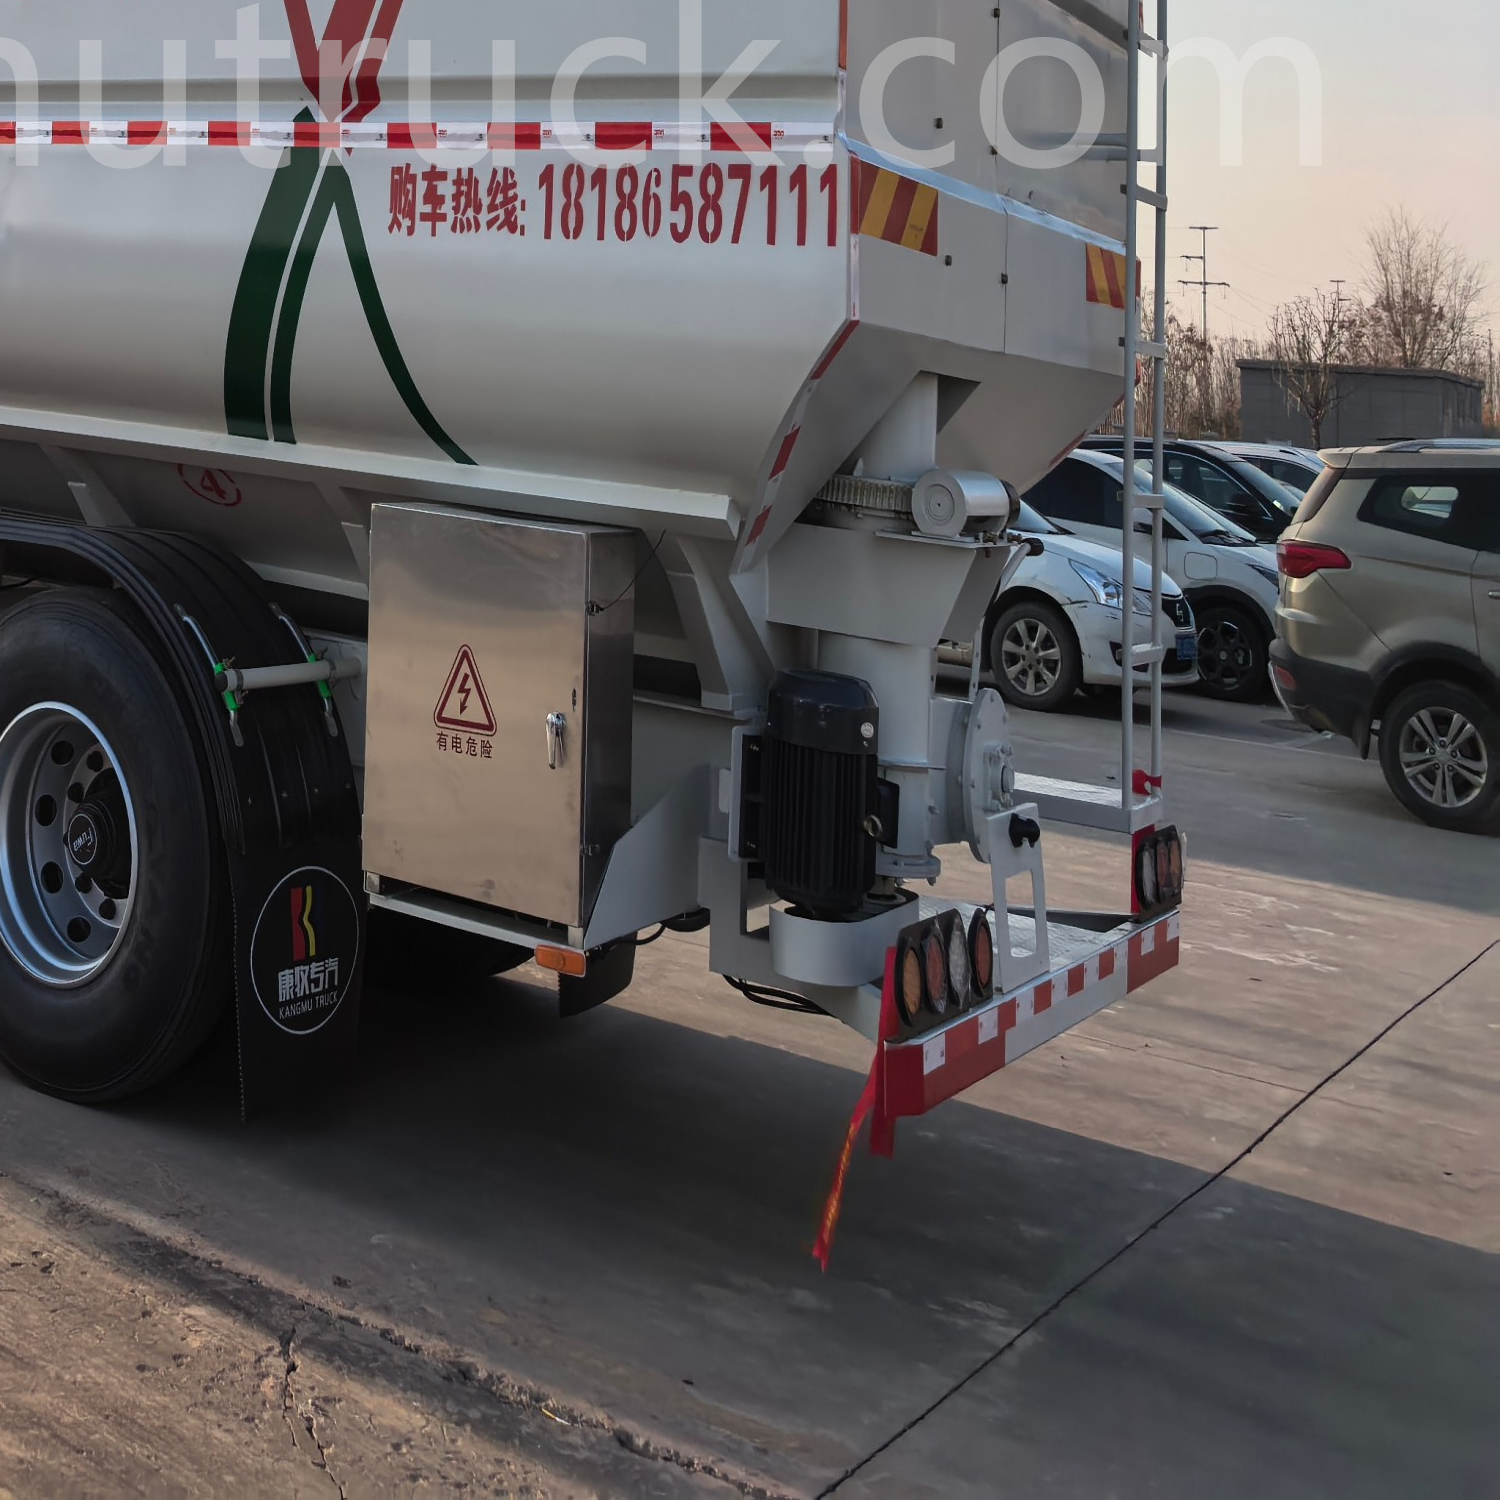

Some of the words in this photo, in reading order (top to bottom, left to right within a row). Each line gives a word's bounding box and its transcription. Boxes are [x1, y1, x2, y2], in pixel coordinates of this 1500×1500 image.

[388, 162, 526, 237] 购车热线:
[538, 162, 838, 247] 18186587111
[436, 730, 493, 759] 有电危险
[278, 999, 313, 1020] KANGMU
[315, 990, 338, 1008] TRUCK
